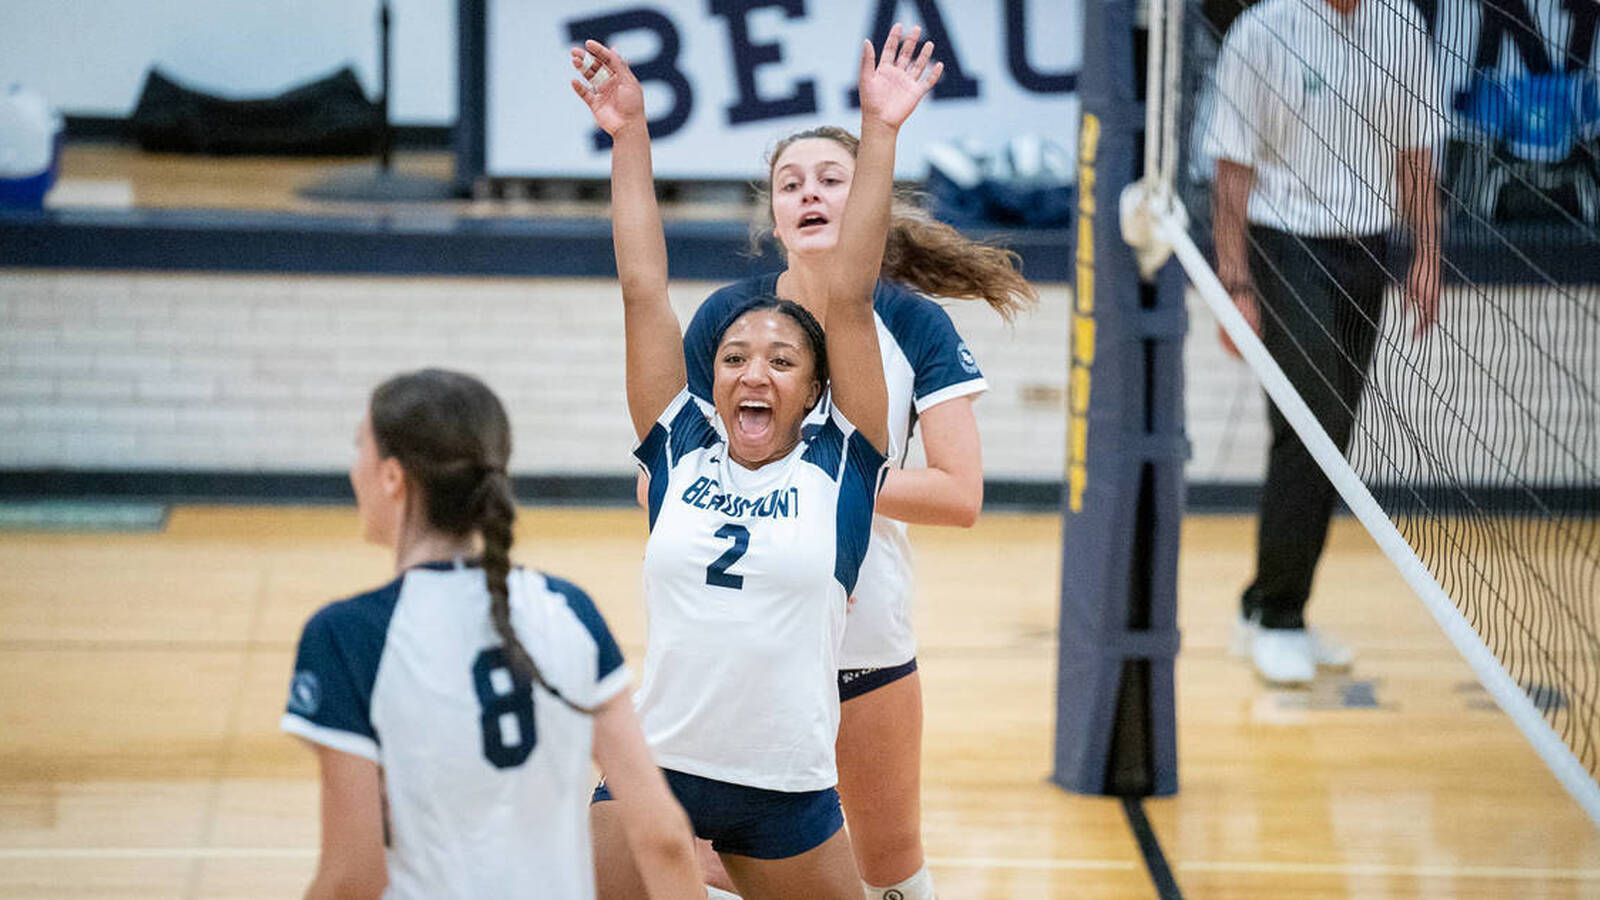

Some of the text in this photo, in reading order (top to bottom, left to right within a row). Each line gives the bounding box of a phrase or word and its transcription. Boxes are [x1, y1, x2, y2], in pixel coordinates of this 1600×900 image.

[681, 475, 799, 519] BEAUMONT
[705, 523, 751, 590] 2
[472, 646, 537, 768] 8
